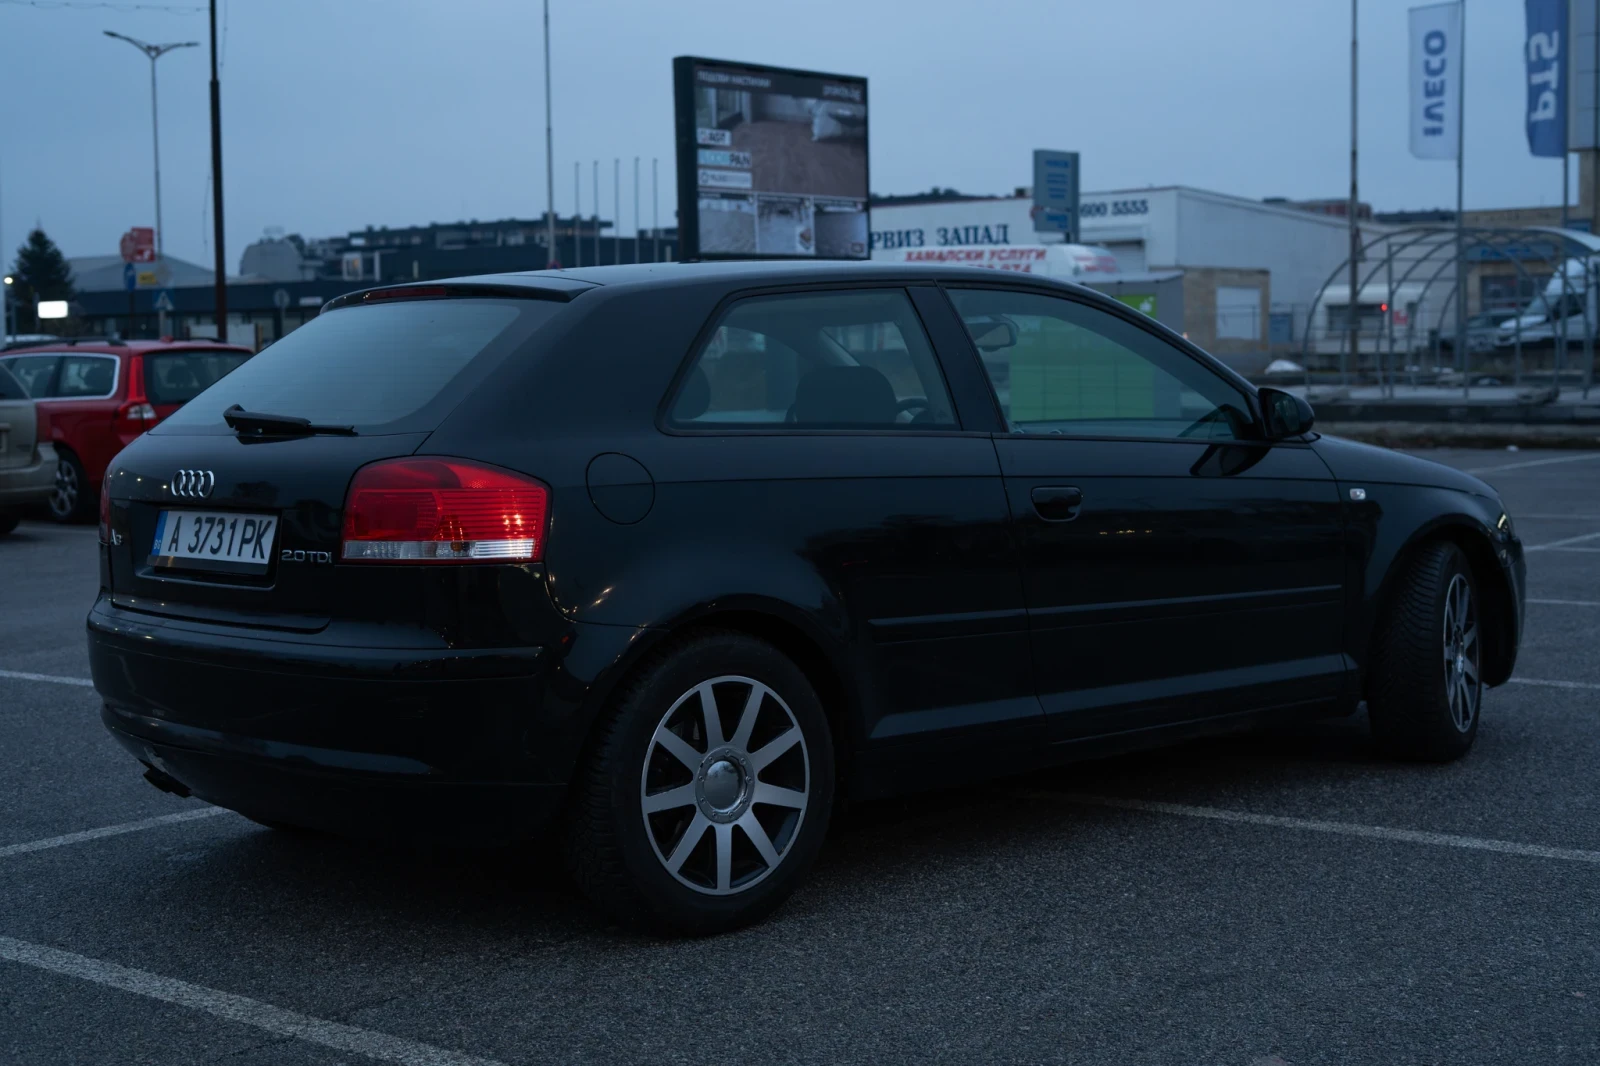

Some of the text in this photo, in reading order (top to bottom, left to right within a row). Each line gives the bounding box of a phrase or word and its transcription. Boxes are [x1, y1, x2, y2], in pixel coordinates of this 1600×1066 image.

[936, 223, 1010, 246] ЗАПАД
[989, 248, 1047, 261] УСЛУГИ
[168, 515, 182, 552] A
